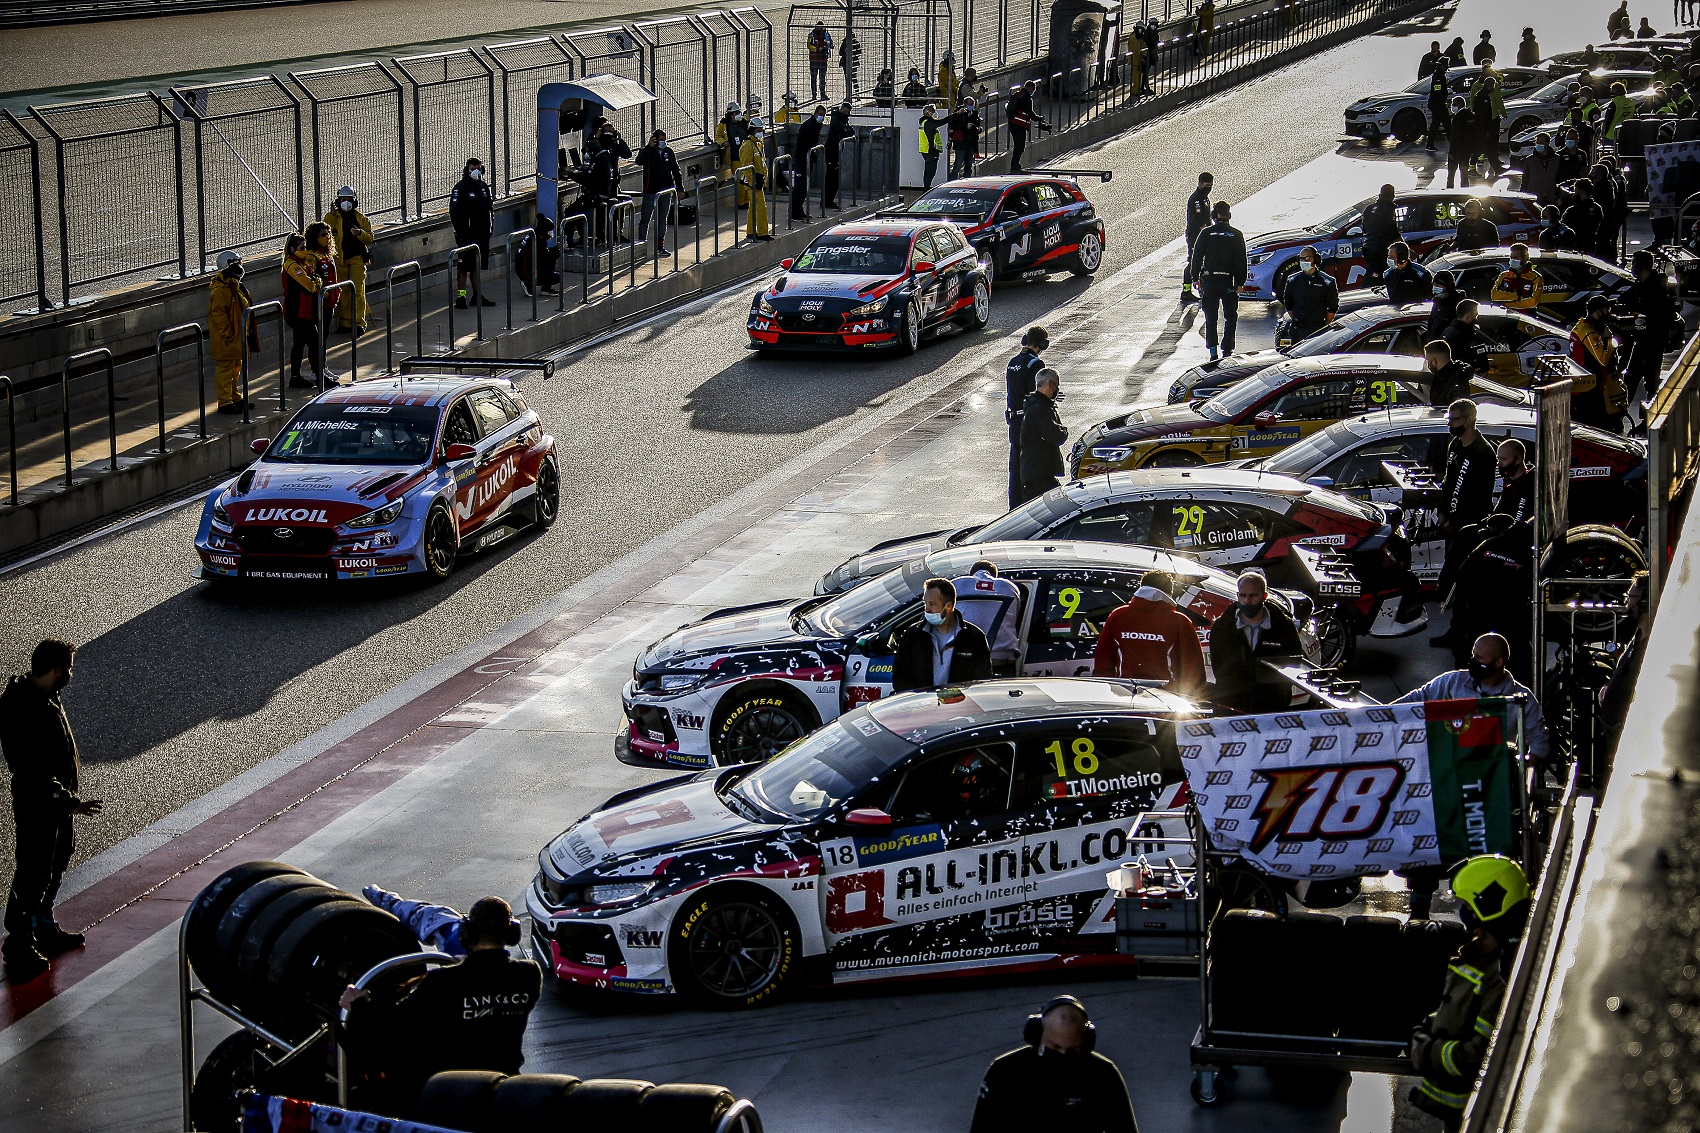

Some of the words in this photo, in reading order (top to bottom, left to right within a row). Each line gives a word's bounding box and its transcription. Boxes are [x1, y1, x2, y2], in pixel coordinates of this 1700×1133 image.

[1436, 203, 1459, 220] 30
[1043, 222, 1060, 238] LIQUI
[1044, 233, 1061, 248] MOLY
[1339, 246, 1350, 255] 30
[1542, 282, 1568, 292] agnus
[1371, 380, 1398, 403] 31
[292, 420, 359, 430] N.Michelisz
[282, 430, 300, 451] 1
[1232, 437, 1246, 448] 31
[1250, 431, 1298, 441] GOODYEAR
[1576, 467, 1609, 477] Castrol
[479, 454, 518, 507] LUKOIL
[245, 508, 328, 523] LUKOIL
[1175, 505, 1204, 536] 29
[1192, 533, 1206, 546] N.
[1208, 528, 1259, 544] Girolami
[210, 554, 236, 566] LUKOIL
[340, 558, 378, 568] LUKOIL
[1058, 588, 1081, 619] 9
[1120, 631, 1166, 642] HONDA
[852, 660, 862, 676] 9
[869, 665, 893, 673] GOOD
[677, 714, 705, 728] KW
[669, 752, 706, 764] GOODYEAR
[1045, 737, 1100, 778] 18
[1284, 764, 1400, 837] 18
[860, 832, 938, 856] GOODYEAR
[826, 844, 854, 868] 18
[792, 881, 814, 891] JAS
[897, 900, 930, 916] Alles
[933, 890, 982, 910] einfach
[985, 881, 1039, 902] Internet
[681, 902, 709, 939] EAGLE
[984, 904, 1074, 929] brose
[627, 930, 664, 946] KW
[835, 940, 1040, 970] www.muennich-motorsport.com
